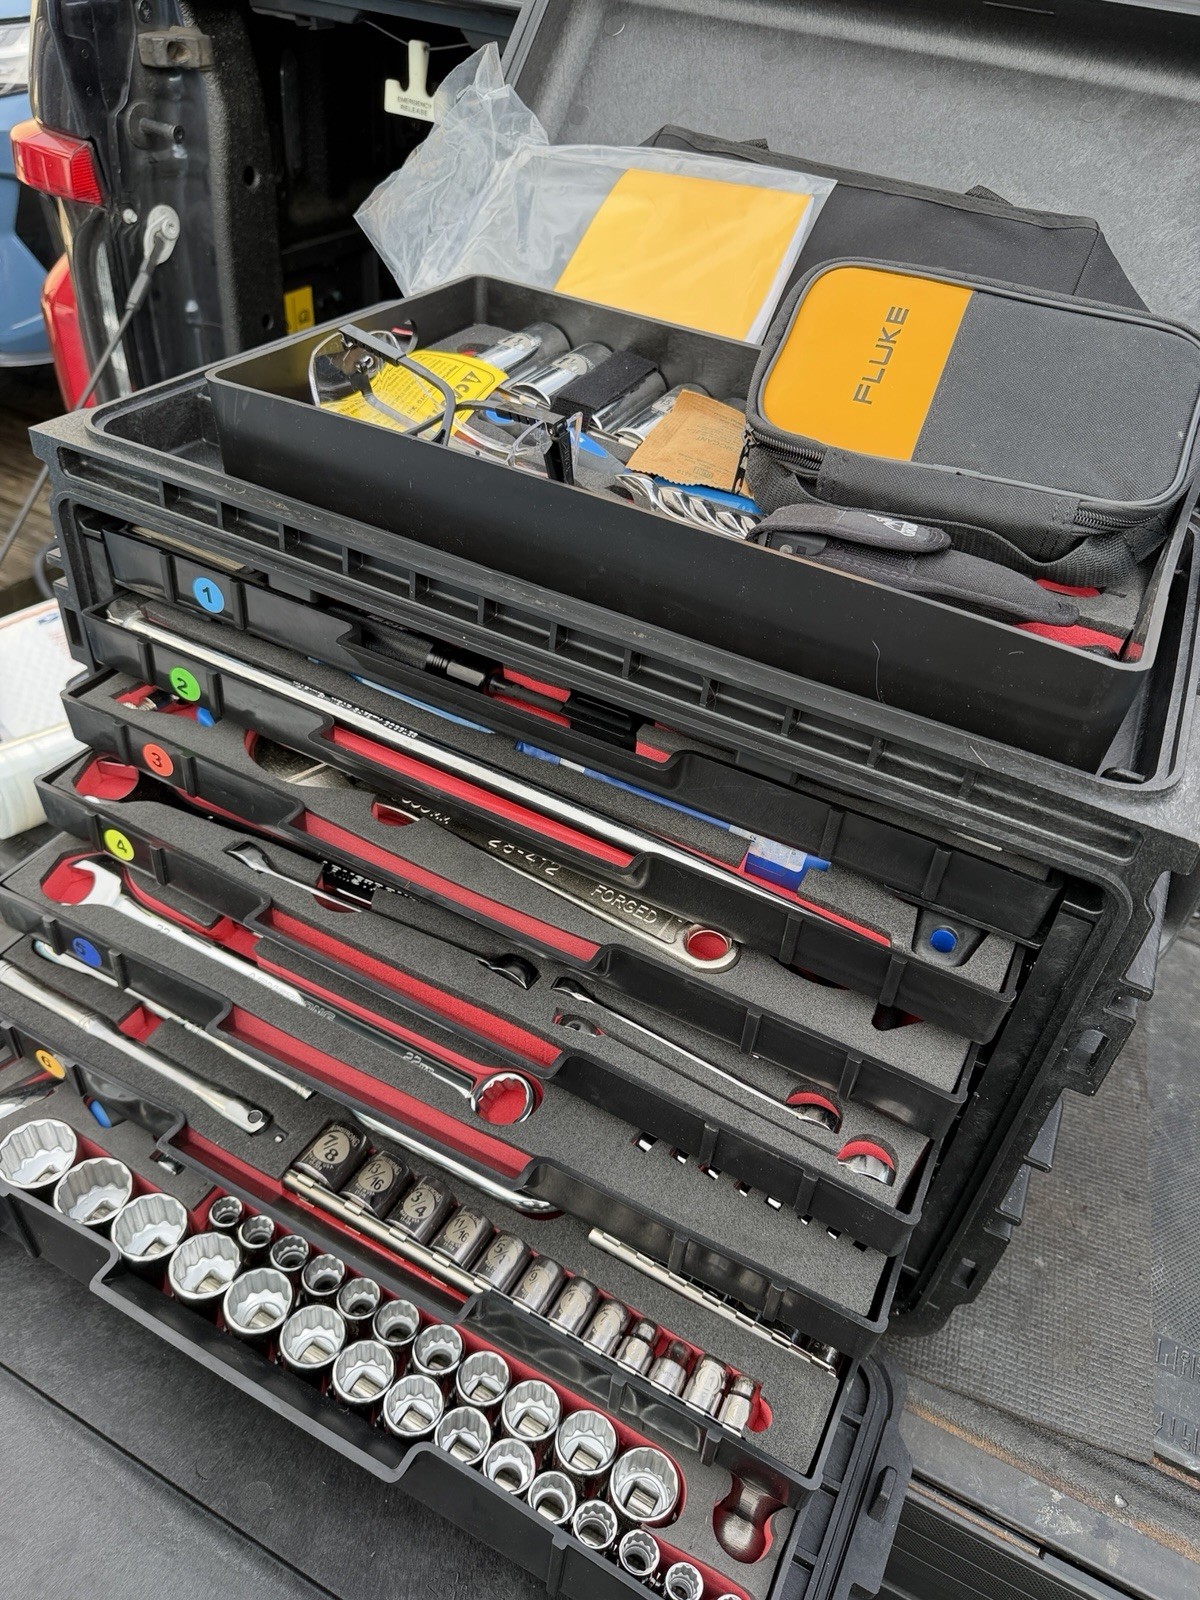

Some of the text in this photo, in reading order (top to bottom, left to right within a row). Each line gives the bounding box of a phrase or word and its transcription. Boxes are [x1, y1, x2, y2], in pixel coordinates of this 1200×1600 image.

[397, 96, 432, 110] EMERGENCY
[400, 104, 428, 117] RELEASE
[853, 306, 909, 405] FLUKE
[202, 586, 212, 604] 1
[176, 677, 188, 695] 2
[151, 752, 162, 768] 3
[117, 839, 127, 853] 4
[591, 884, 658, 924] FORGED
[75, 941, 86, 955] 5
[41, 1055, 52, 1068] 6
[324, 1134, 338, 1161] 7/8
[365, 1162, 386, 1191] 13/16
[410, 1191, 427, 1217] 3/4
[453, 1217, 470, 1242] 11/16
